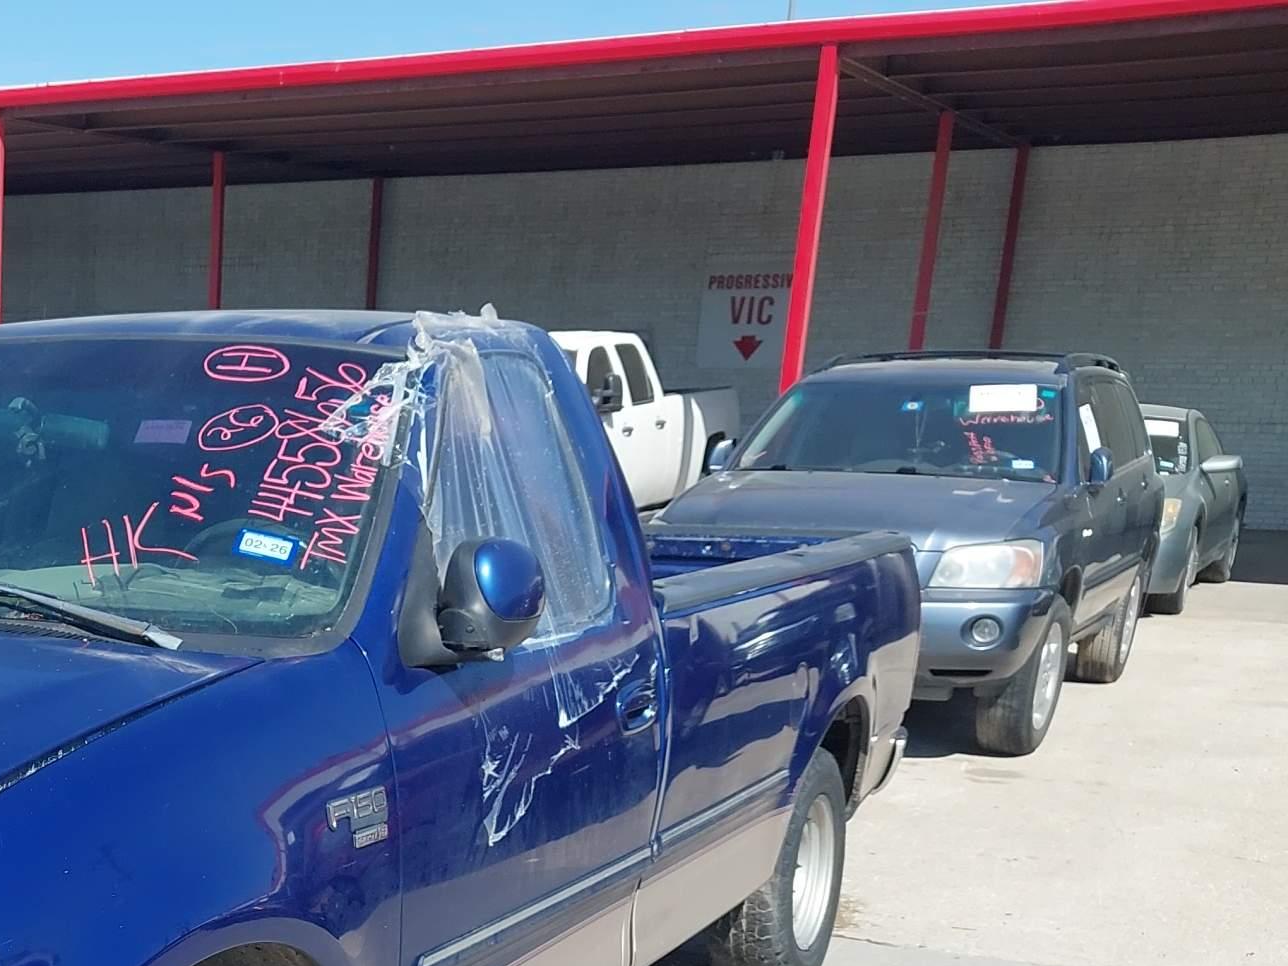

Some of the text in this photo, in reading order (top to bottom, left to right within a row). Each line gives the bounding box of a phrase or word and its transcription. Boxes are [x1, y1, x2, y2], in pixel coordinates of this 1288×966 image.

[708, 273, 793, 290] PROGRESSIV
[730, 296, 775, 325] VIC
[207, 407, 264, 441] 26
[81, 502, 199, 590] HK
[300, 508, 362, 570] TMX
